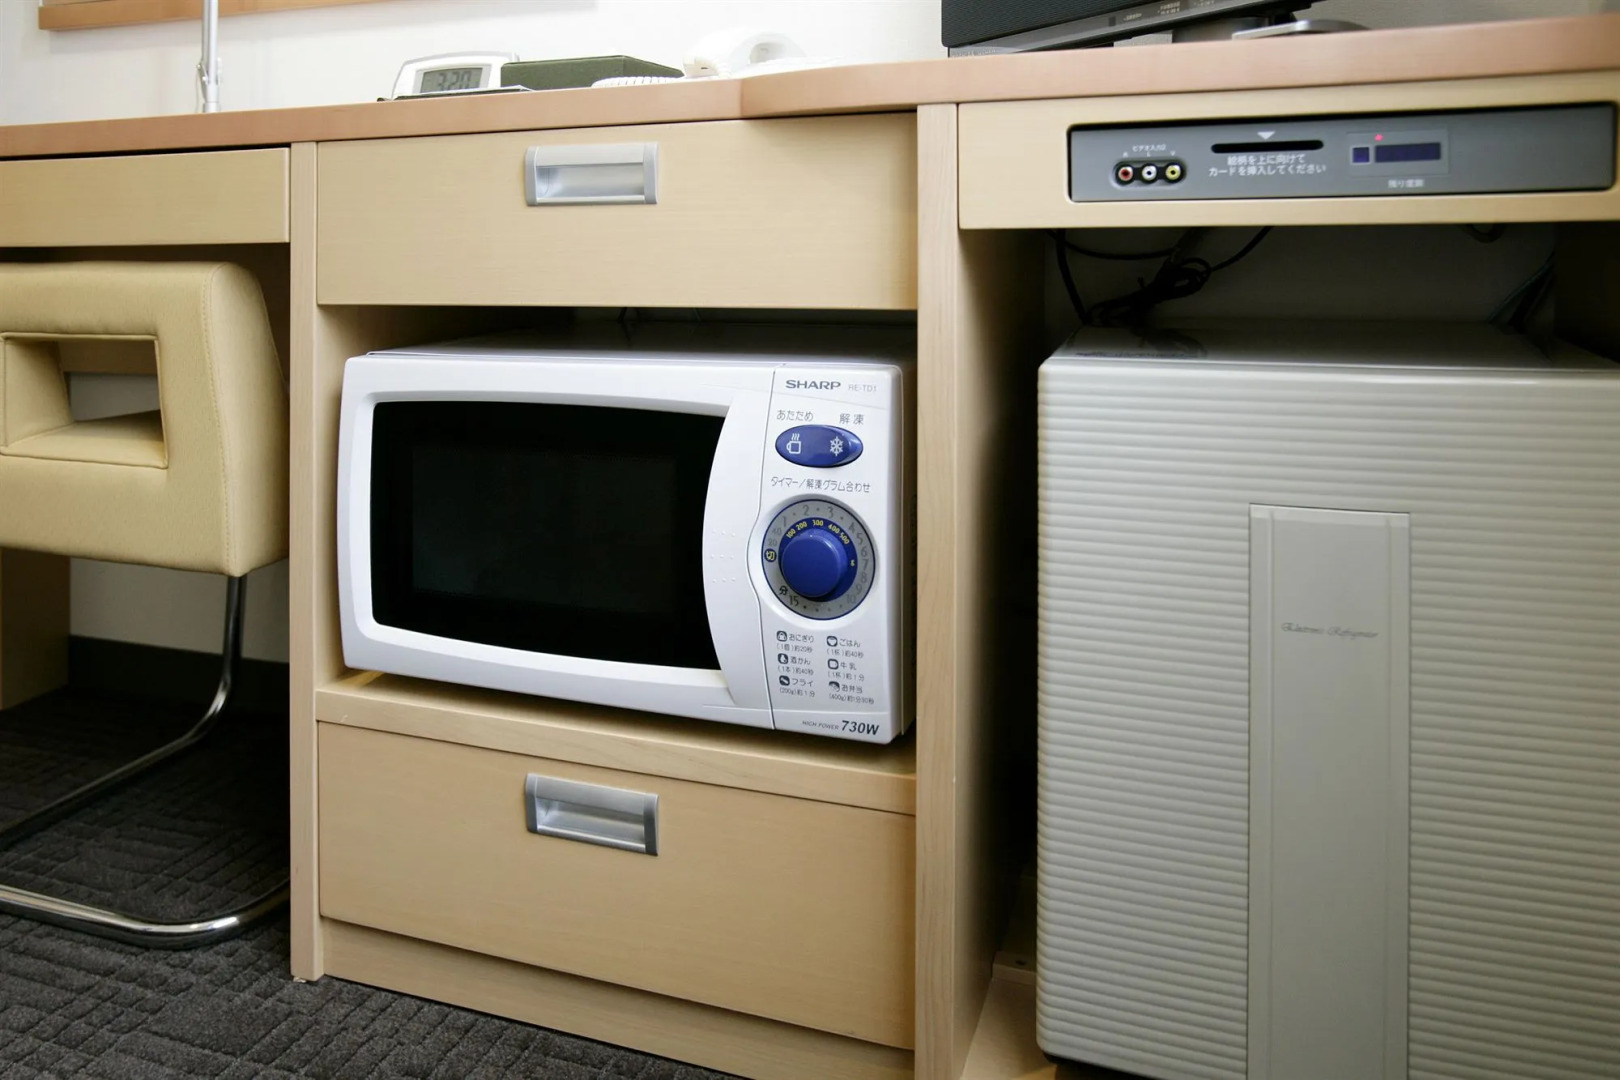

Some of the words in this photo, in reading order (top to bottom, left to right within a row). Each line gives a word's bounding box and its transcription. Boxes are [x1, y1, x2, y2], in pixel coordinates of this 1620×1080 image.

[1208, 164, 1327, 177] カードを挿入してください
[785, 379, 841, 390] SHARP
[776, 409, 814, 422] あたため
[802, 504, 810, 517] 2
[827, 506, 834, 518] 3
[795, 521, 808, 531] 200
[812, 519, 824, 527] 300
[828, 523, 840, 534] 400
[786, 529, 796, 539] 100
[839, 532, 850, 545] 500
[789, 595, 799, 606] 15
[846, 594, 857, 604] 10
[789, 633, 815, 643] おにぎり
[839, 638, 861, 648] ごはん
[790, 656, 811, 665] 酒かん
[840, 661, 857, 671] 牛乳
[791, 678, 814, 687] フライ
[841, 684, 863, 694] お弁当
[818, 722, 839, 730] POWER
[842, 719, 880, 736] 730W
